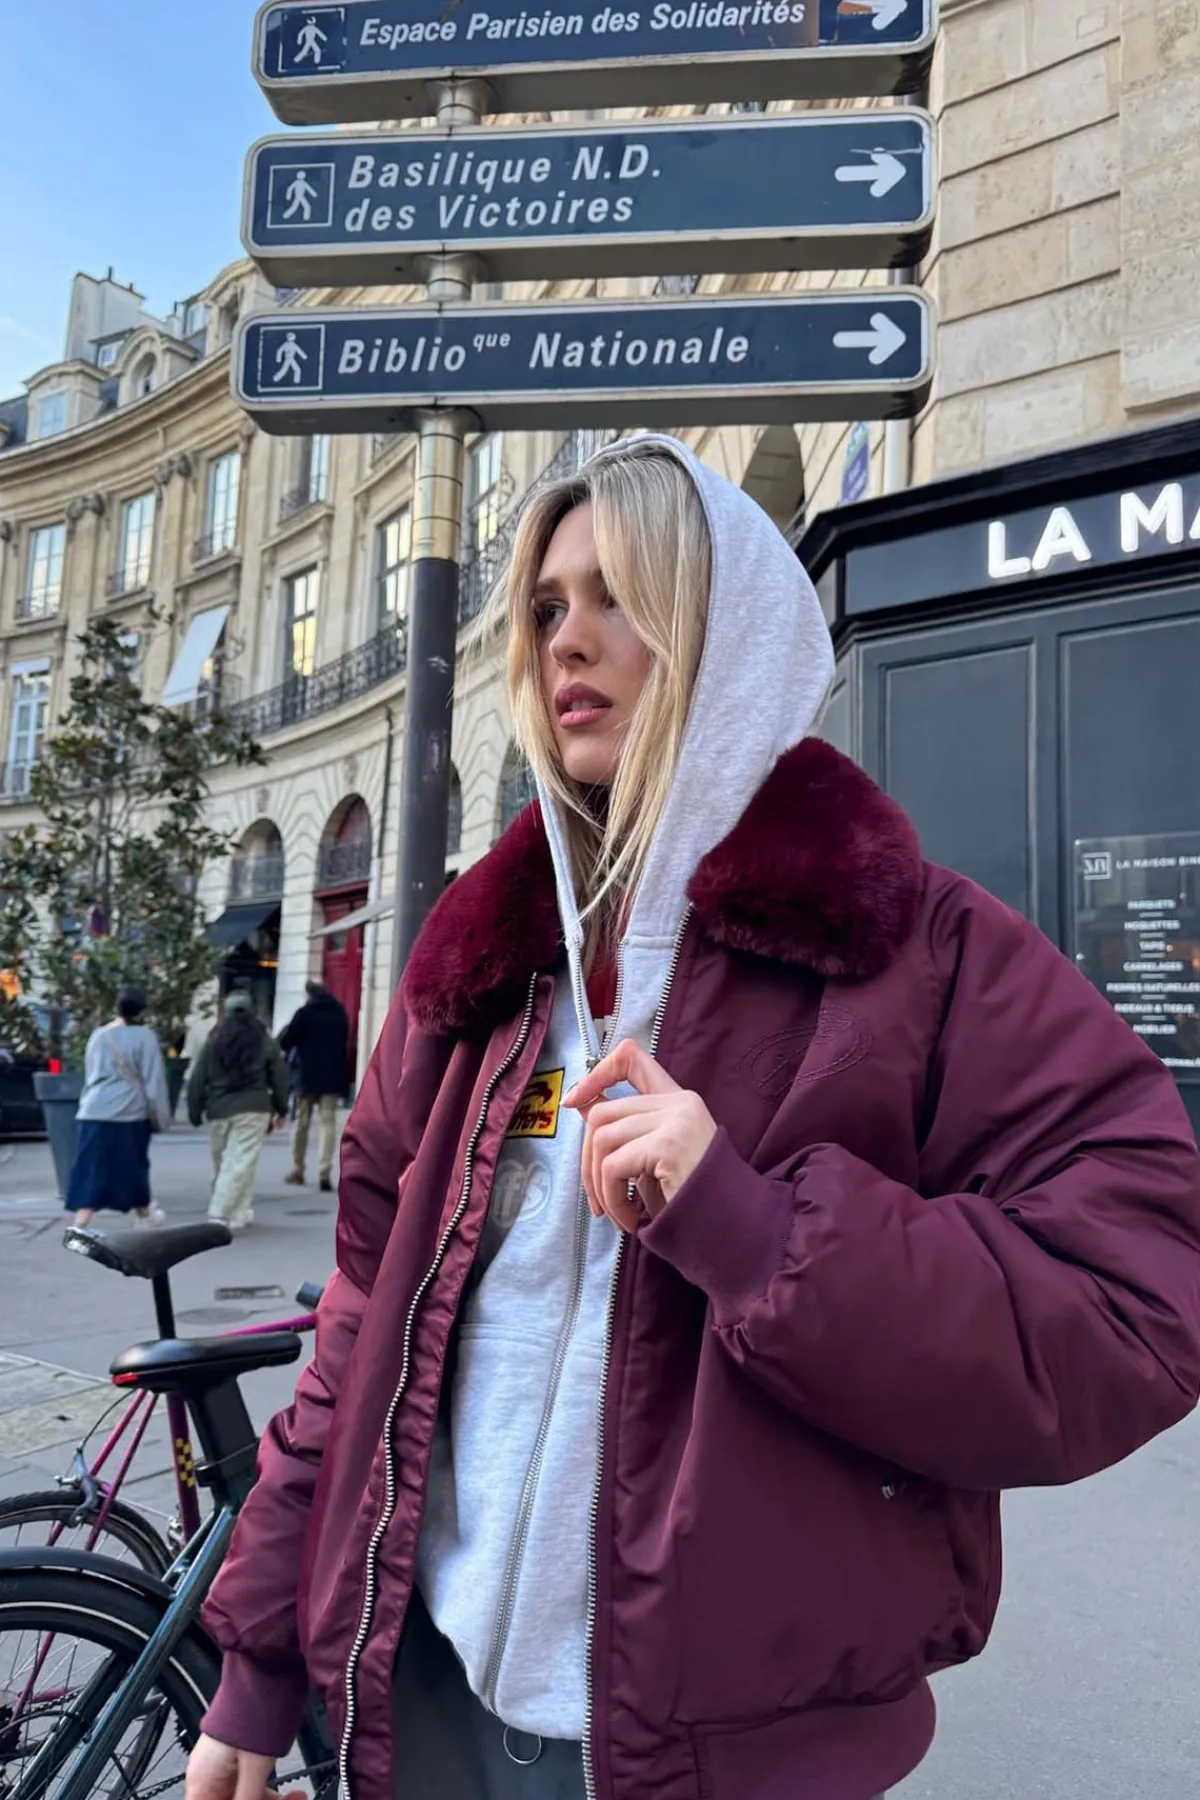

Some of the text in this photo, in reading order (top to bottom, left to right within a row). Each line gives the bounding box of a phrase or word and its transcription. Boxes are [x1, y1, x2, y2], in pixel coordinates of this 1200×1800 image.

[360, 0, 806, 50] Espace Parisien des Solidarités
[348, 144, 661, 193] Basilique N.D.
[344, 191, 634, 232] des Victoires
[529, 327, 750, 369] Nationale
[988, 482, 1200, 579] LA M
